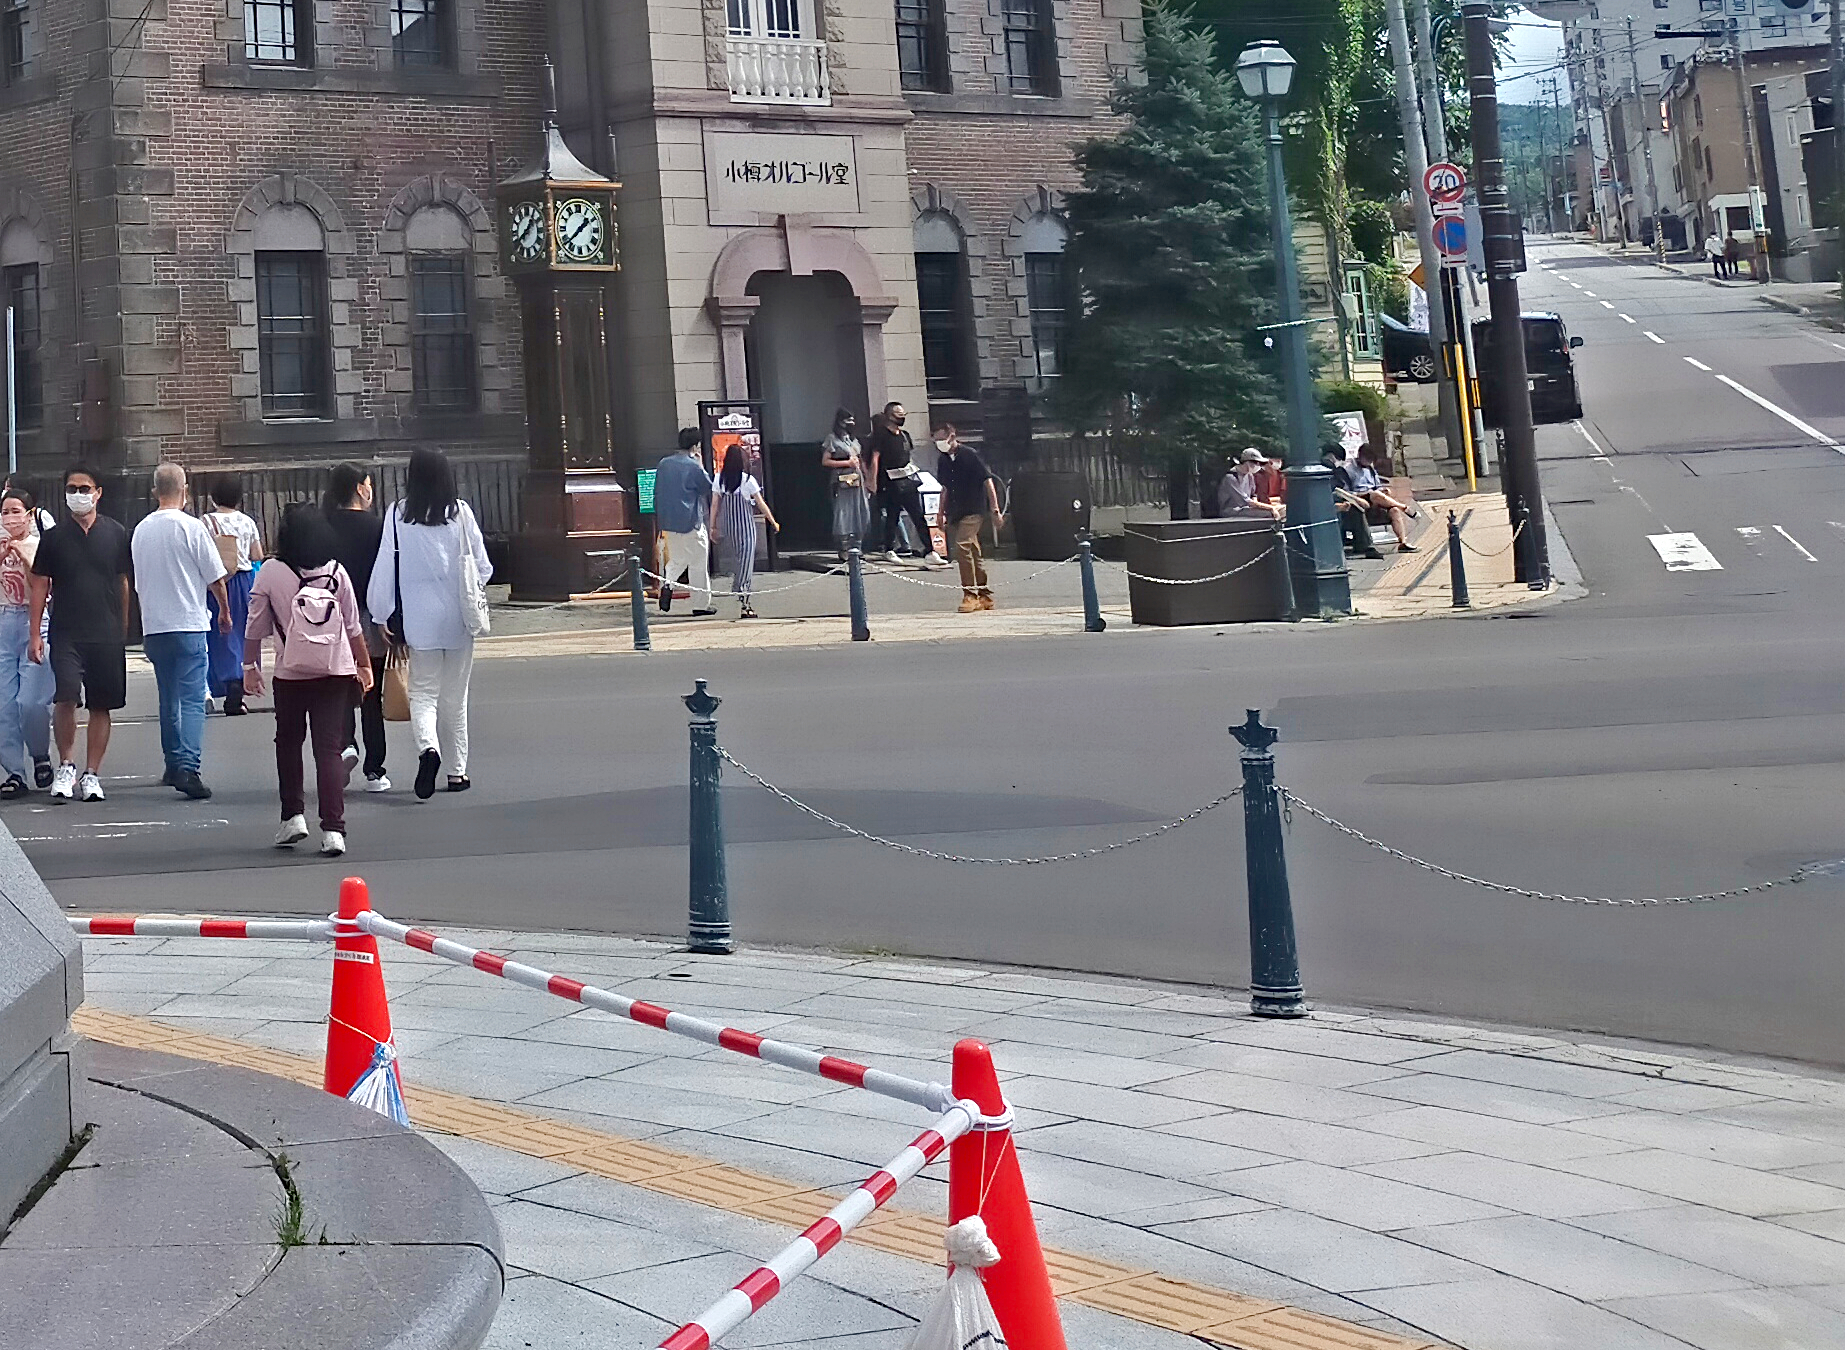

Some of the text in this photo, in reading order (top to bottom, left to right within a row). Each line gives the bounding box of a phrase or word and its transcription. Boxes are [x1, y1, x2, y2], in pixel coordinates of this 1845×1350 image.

[725, 160, 849, 184] 小樽オルゴール堂
